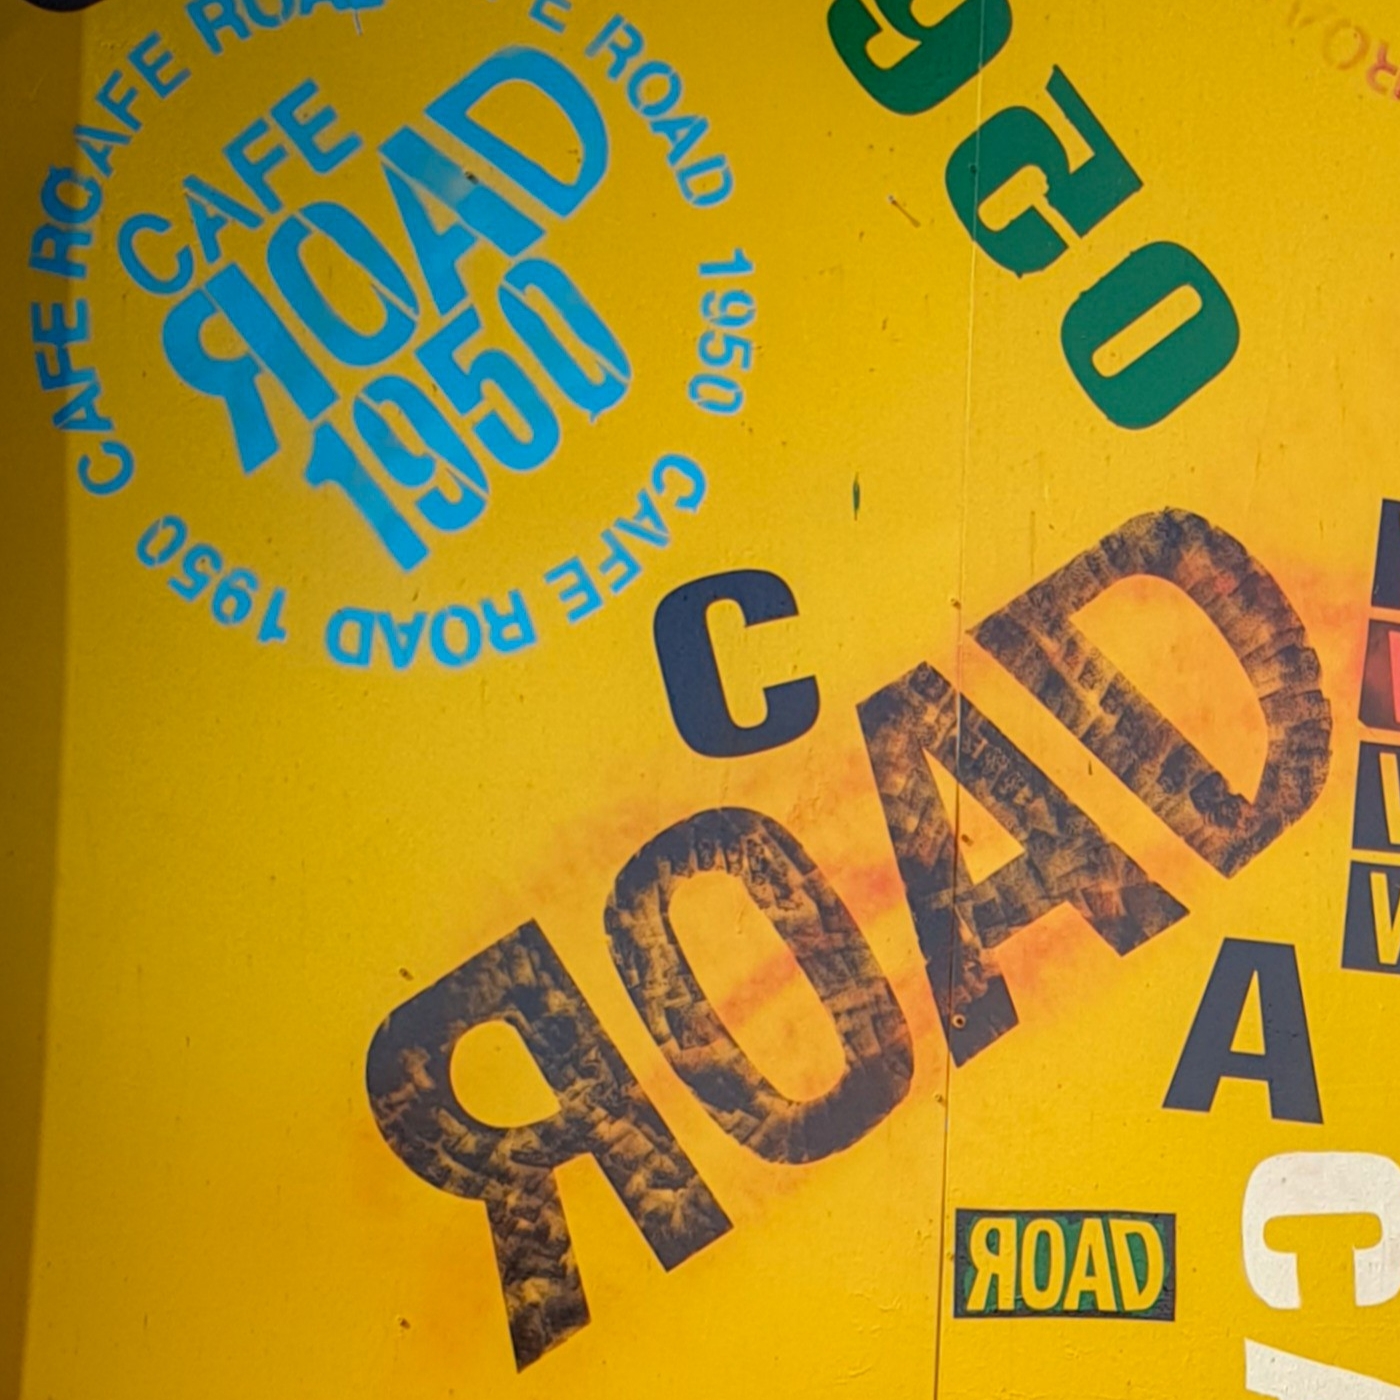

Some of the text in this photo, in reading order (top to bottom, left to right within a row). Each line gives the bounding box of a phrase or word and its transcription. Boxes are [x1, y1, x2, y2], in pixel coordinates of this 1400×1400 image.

[116, 78, 363, 295] CAFE
[585, 14, 733, 207] ROAD
[30, 299, 135, 496] CAFE
[304, 257, 632, 573] 1950
[687, 248, 755, 415] 1950
[136, 515, 288, 643] 1950
[324, 589, 538, 670] ROAD
[544, 452, 708, 623] CAFE
[365, 505, 1333, 1374] ROAD
